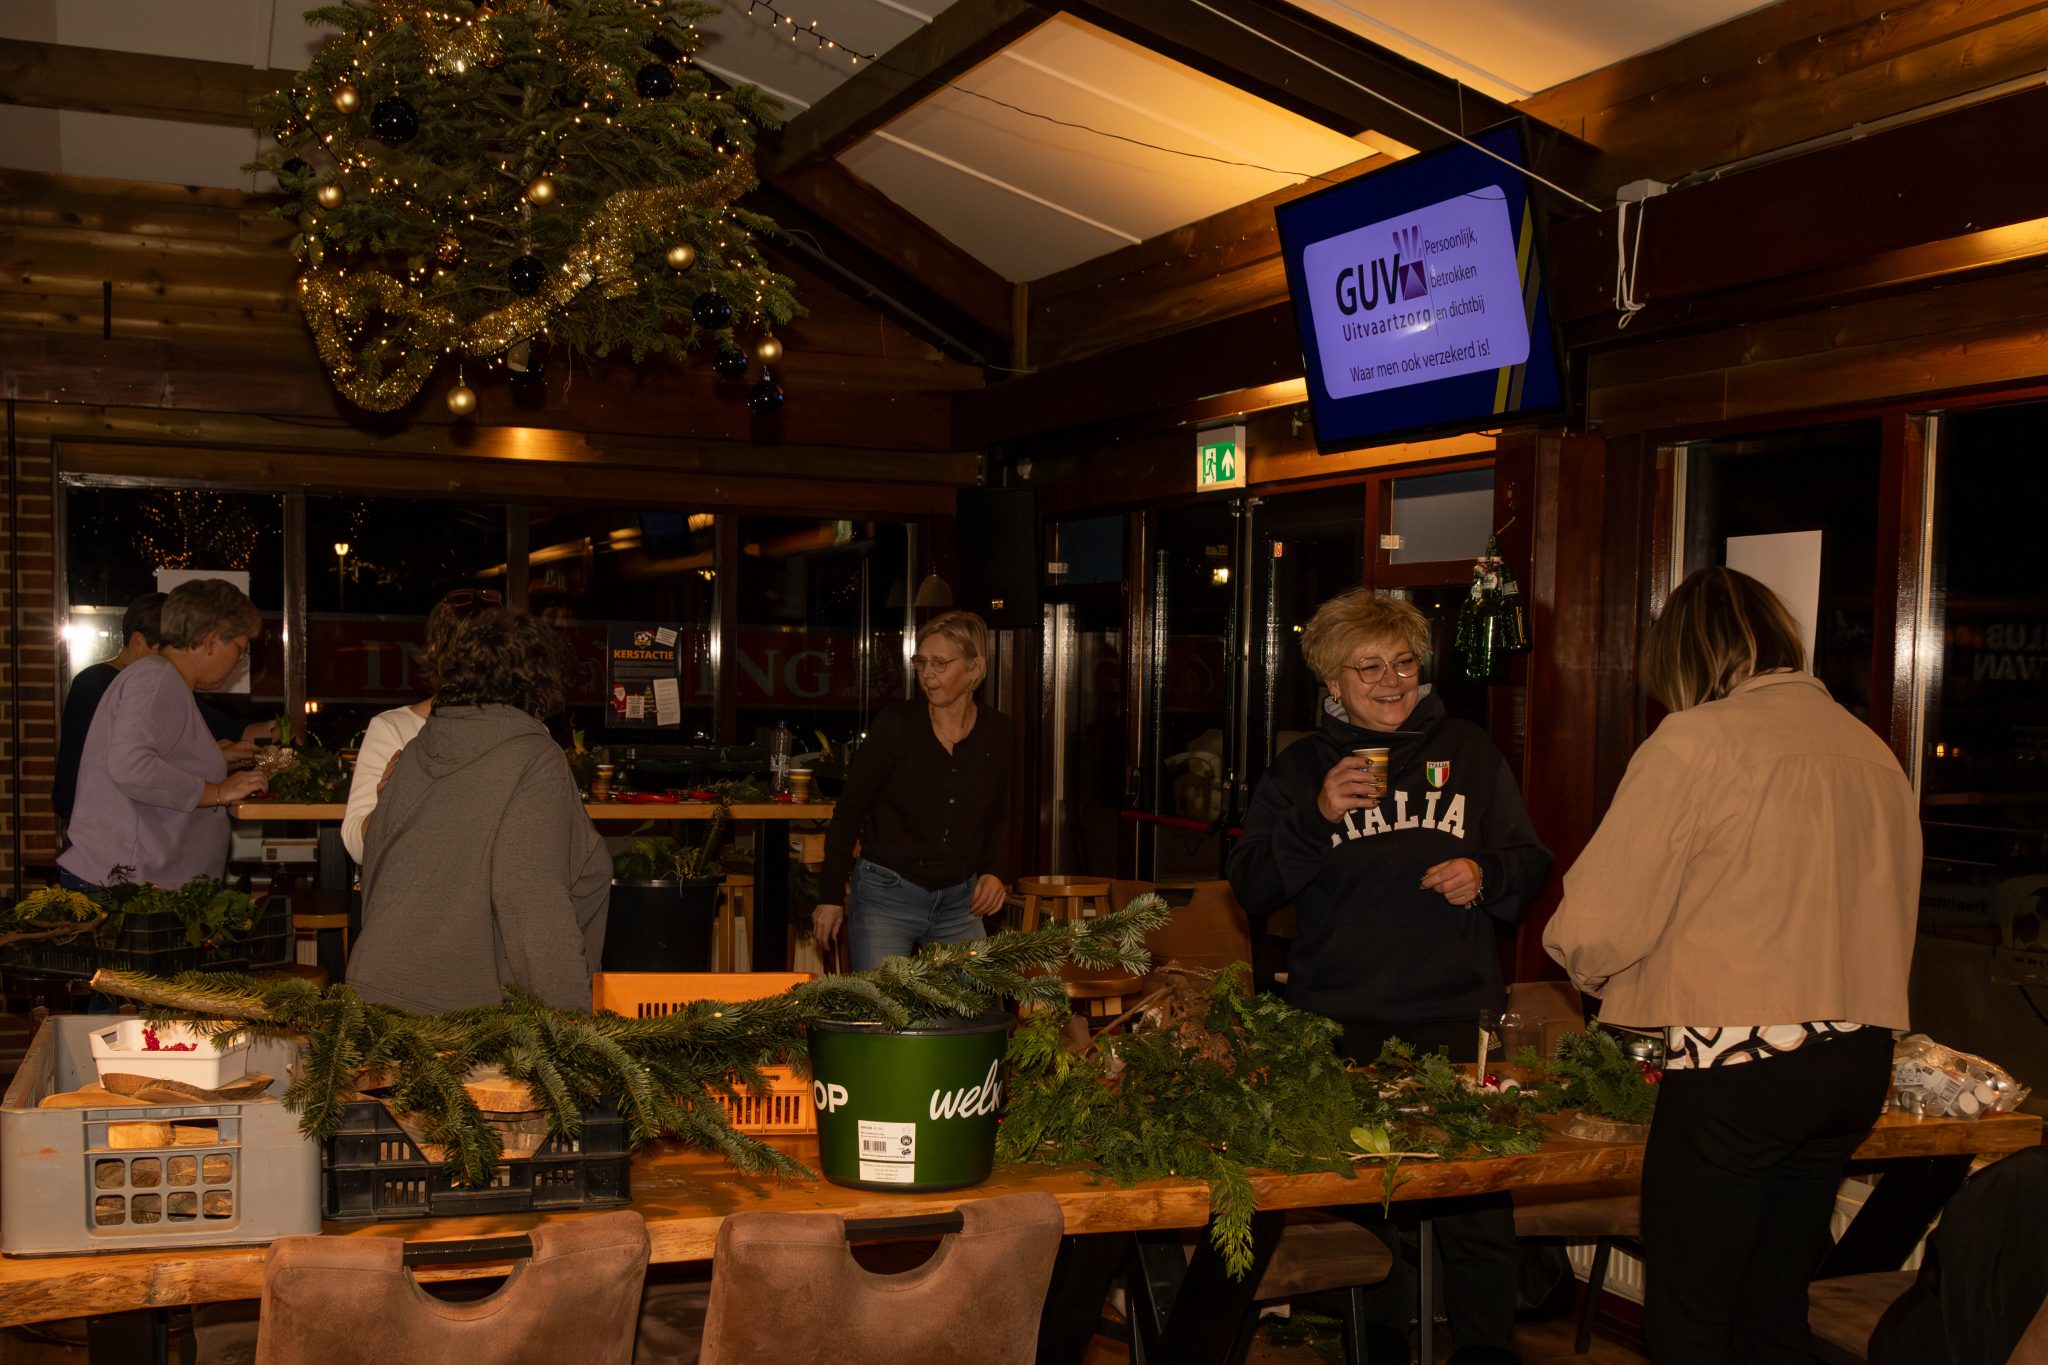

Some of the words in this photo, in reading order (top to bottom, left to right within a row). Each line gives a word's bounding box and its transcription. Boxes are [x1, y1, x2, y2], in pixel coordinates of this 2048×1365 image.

[1424, 226, 1478, 256] Persoonlijk,
[1335, 252, 1401, 316] GUV
[1430, 264, 1478, 288] betrokken
[1435, 307, 1448, 321] en
[1449, 293, 1486, 318] dichtbij
[1342, 306, 1432, 342] Uitvaartzorg
[1350, 365, 1374, 383] Waar
[1377, 361, 1400, 378] men
[1401, 352, 1422, 373] ook
[1422, 340, 1476, 368] verzekerd
[1477, 337, 1491, 358] is!
[613, 648, 675, 661] KERSTACTIE
[1331, 789, 1467, 849] TALIA
